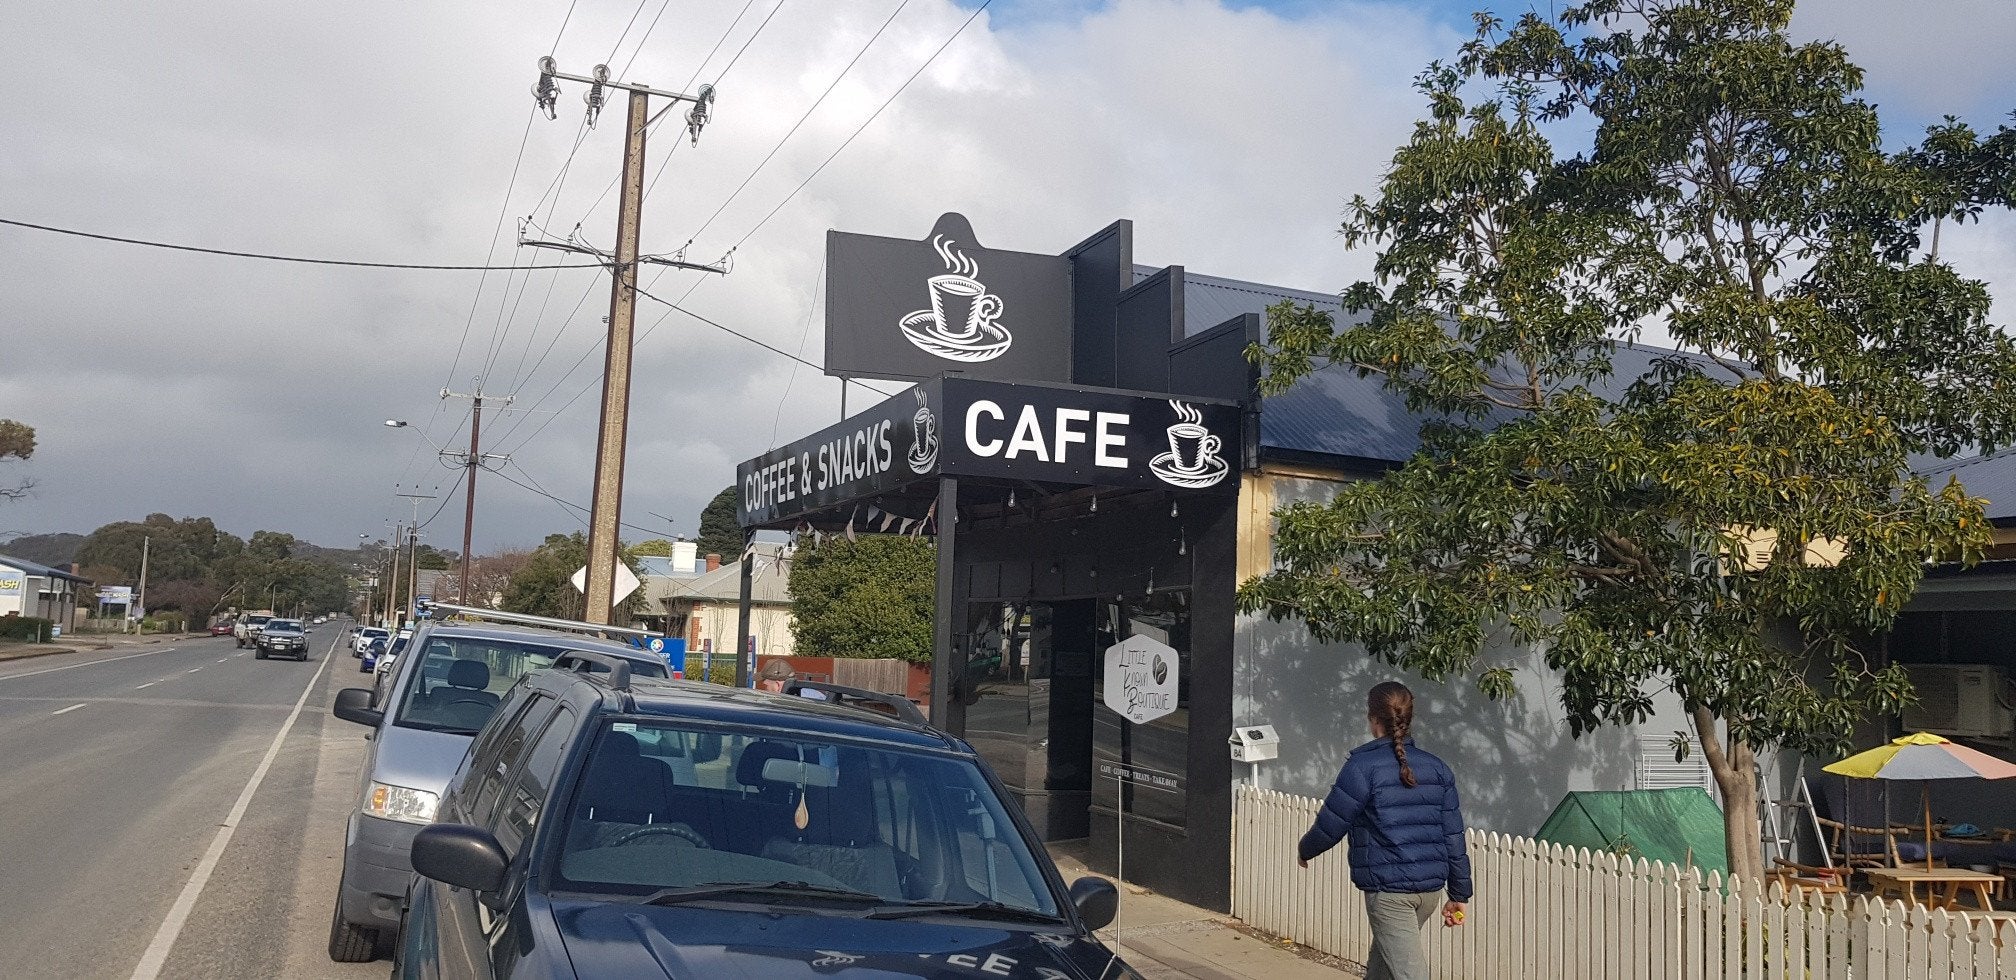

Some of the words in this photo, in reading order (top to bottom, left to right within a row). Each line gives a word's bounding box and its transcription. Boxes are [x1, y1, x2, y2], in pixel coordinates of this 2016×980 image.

[745, 457, 796, 513] COFFEE
[801, 452, 812, 496] &
[817, 419, 892, 491] SNACKS
[965, 400, 1130, 468] CAFE
[1113, 768, 1130, 778] COFFEE
[1132, 771, 1150, 782] TREATS
